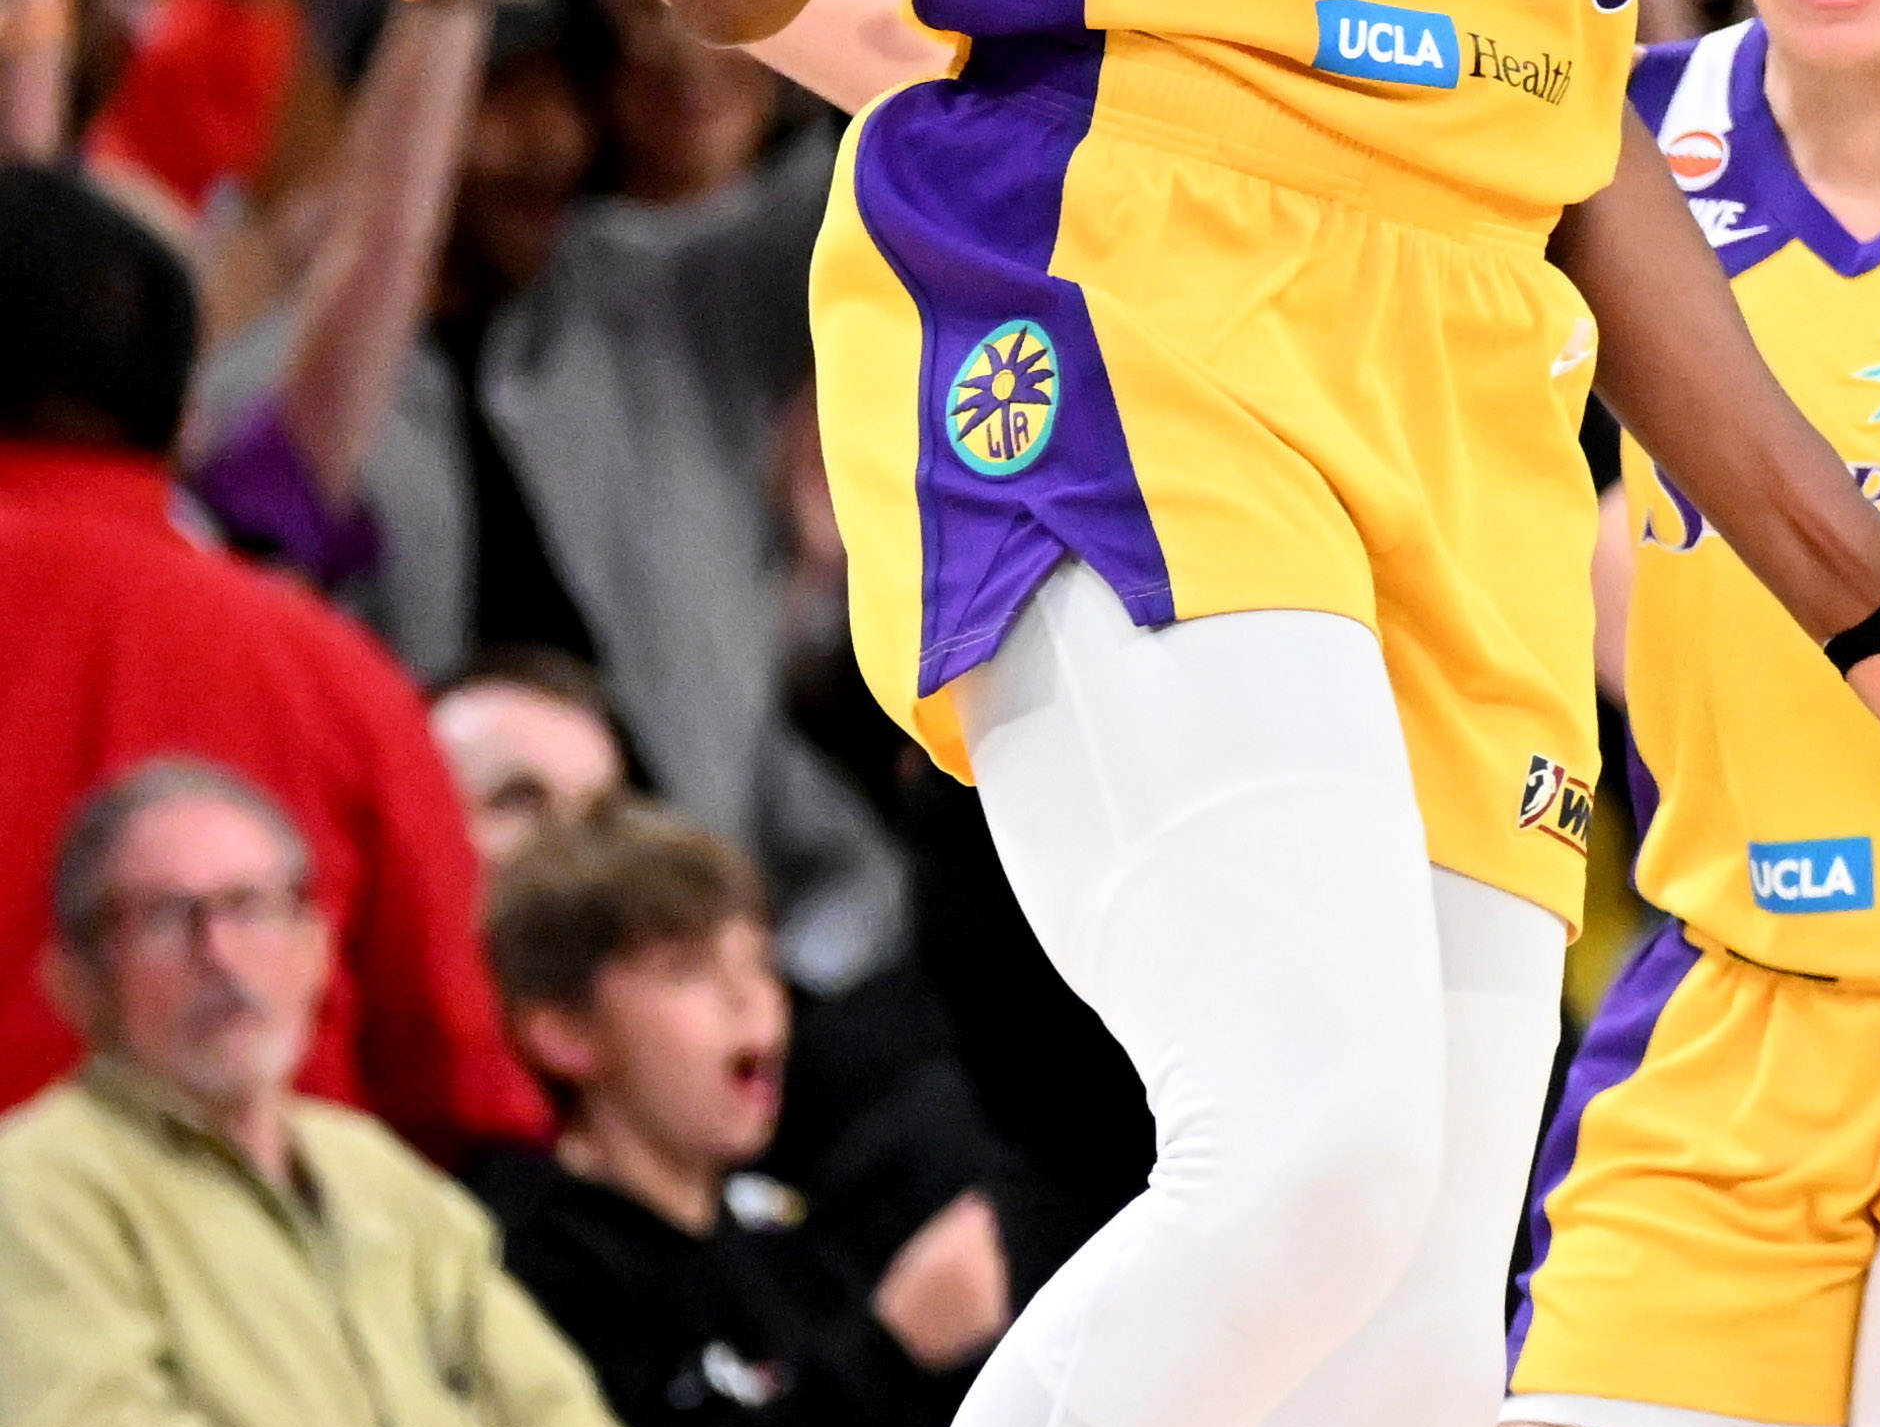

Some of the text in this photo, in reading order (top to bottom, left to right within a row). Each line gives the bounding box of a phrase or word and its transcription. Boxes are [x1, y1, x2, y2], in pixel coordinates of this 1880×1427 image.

[1338, 18, 1573, 106] UCLA Health
[1750, 856, 1856, 900] UCLA
